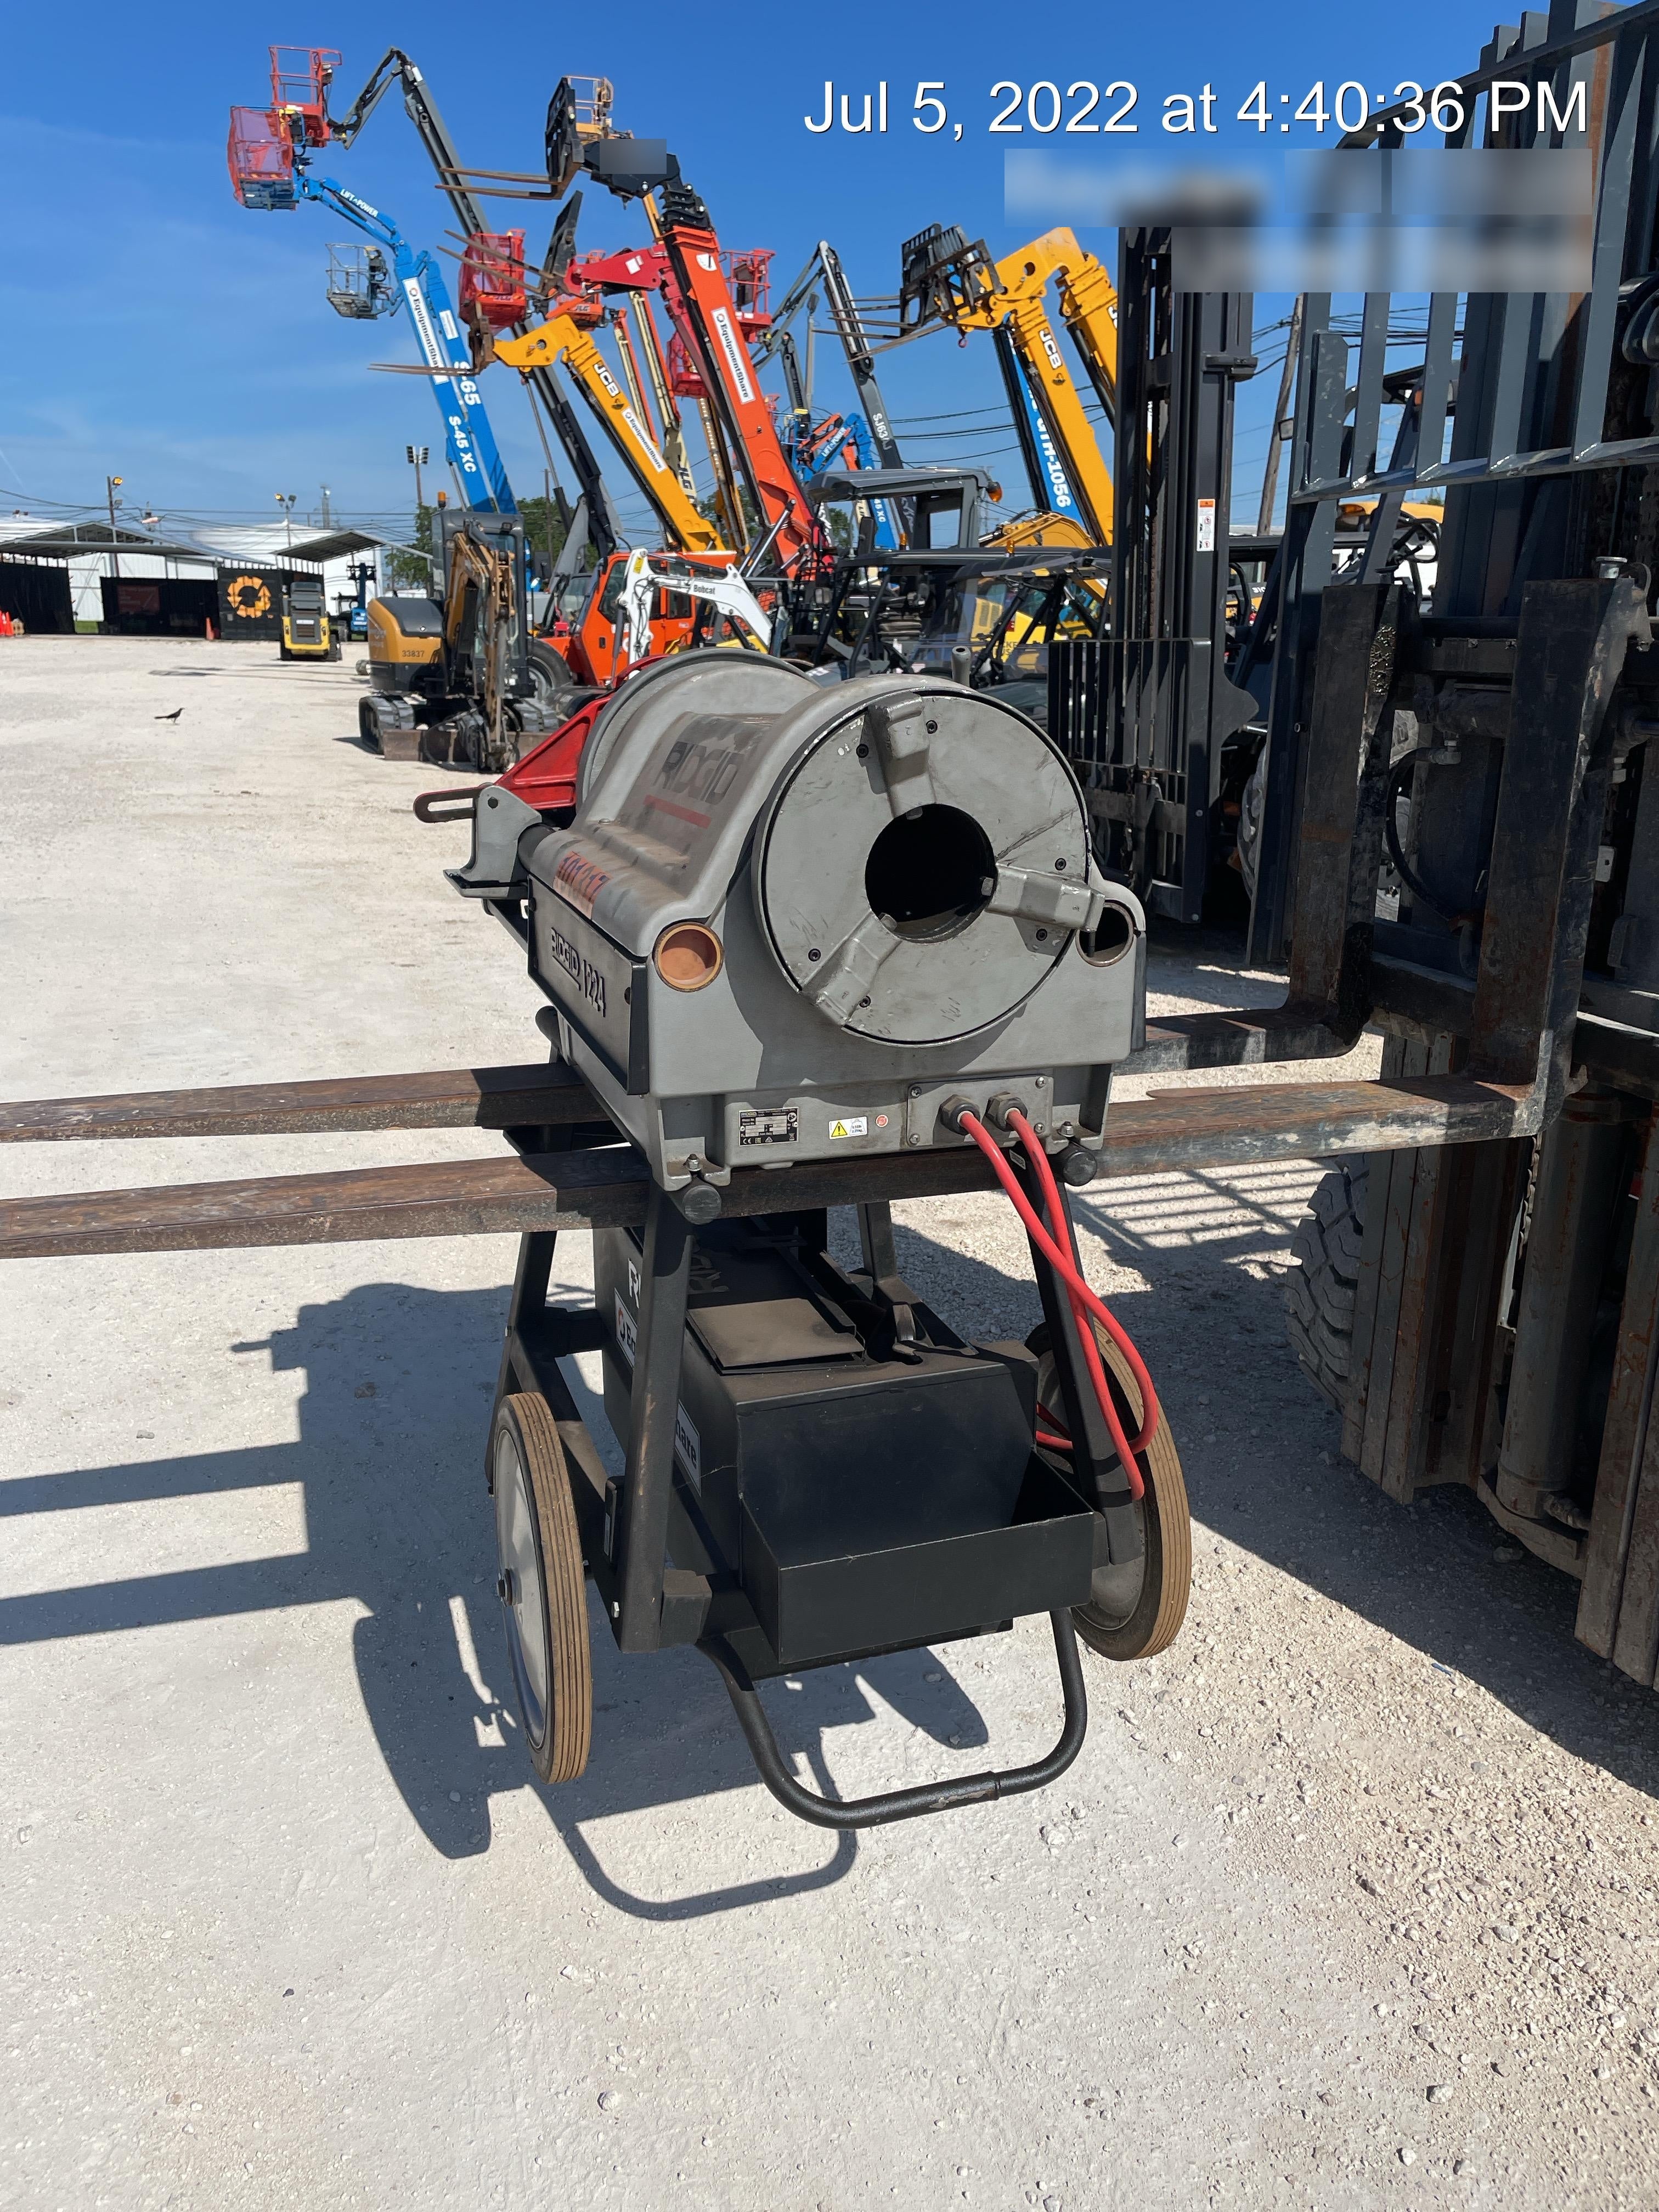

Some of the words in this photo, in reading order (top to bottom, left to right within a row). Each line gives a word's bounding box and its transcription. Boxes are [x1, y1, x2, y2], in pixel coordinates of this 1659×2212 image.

[413, 298, 439, 368] EquipmentSha
[1039, 329, 1062, 369] JCB
[593, 363, 620, 397] JCB
[720, 323, 749, 398] EquipmentShare
[449, 416, 470, 449] S-45
[460, 452, 477, 472] XC
[630, 419, 662, 469] EquipmentShare
[693, 584, 716, 595] Bobcat
[402, 650, 425, 658] 33837
[551, 927, 580, 977] RIDGID
[583, 959, 606, 1018] 1224
